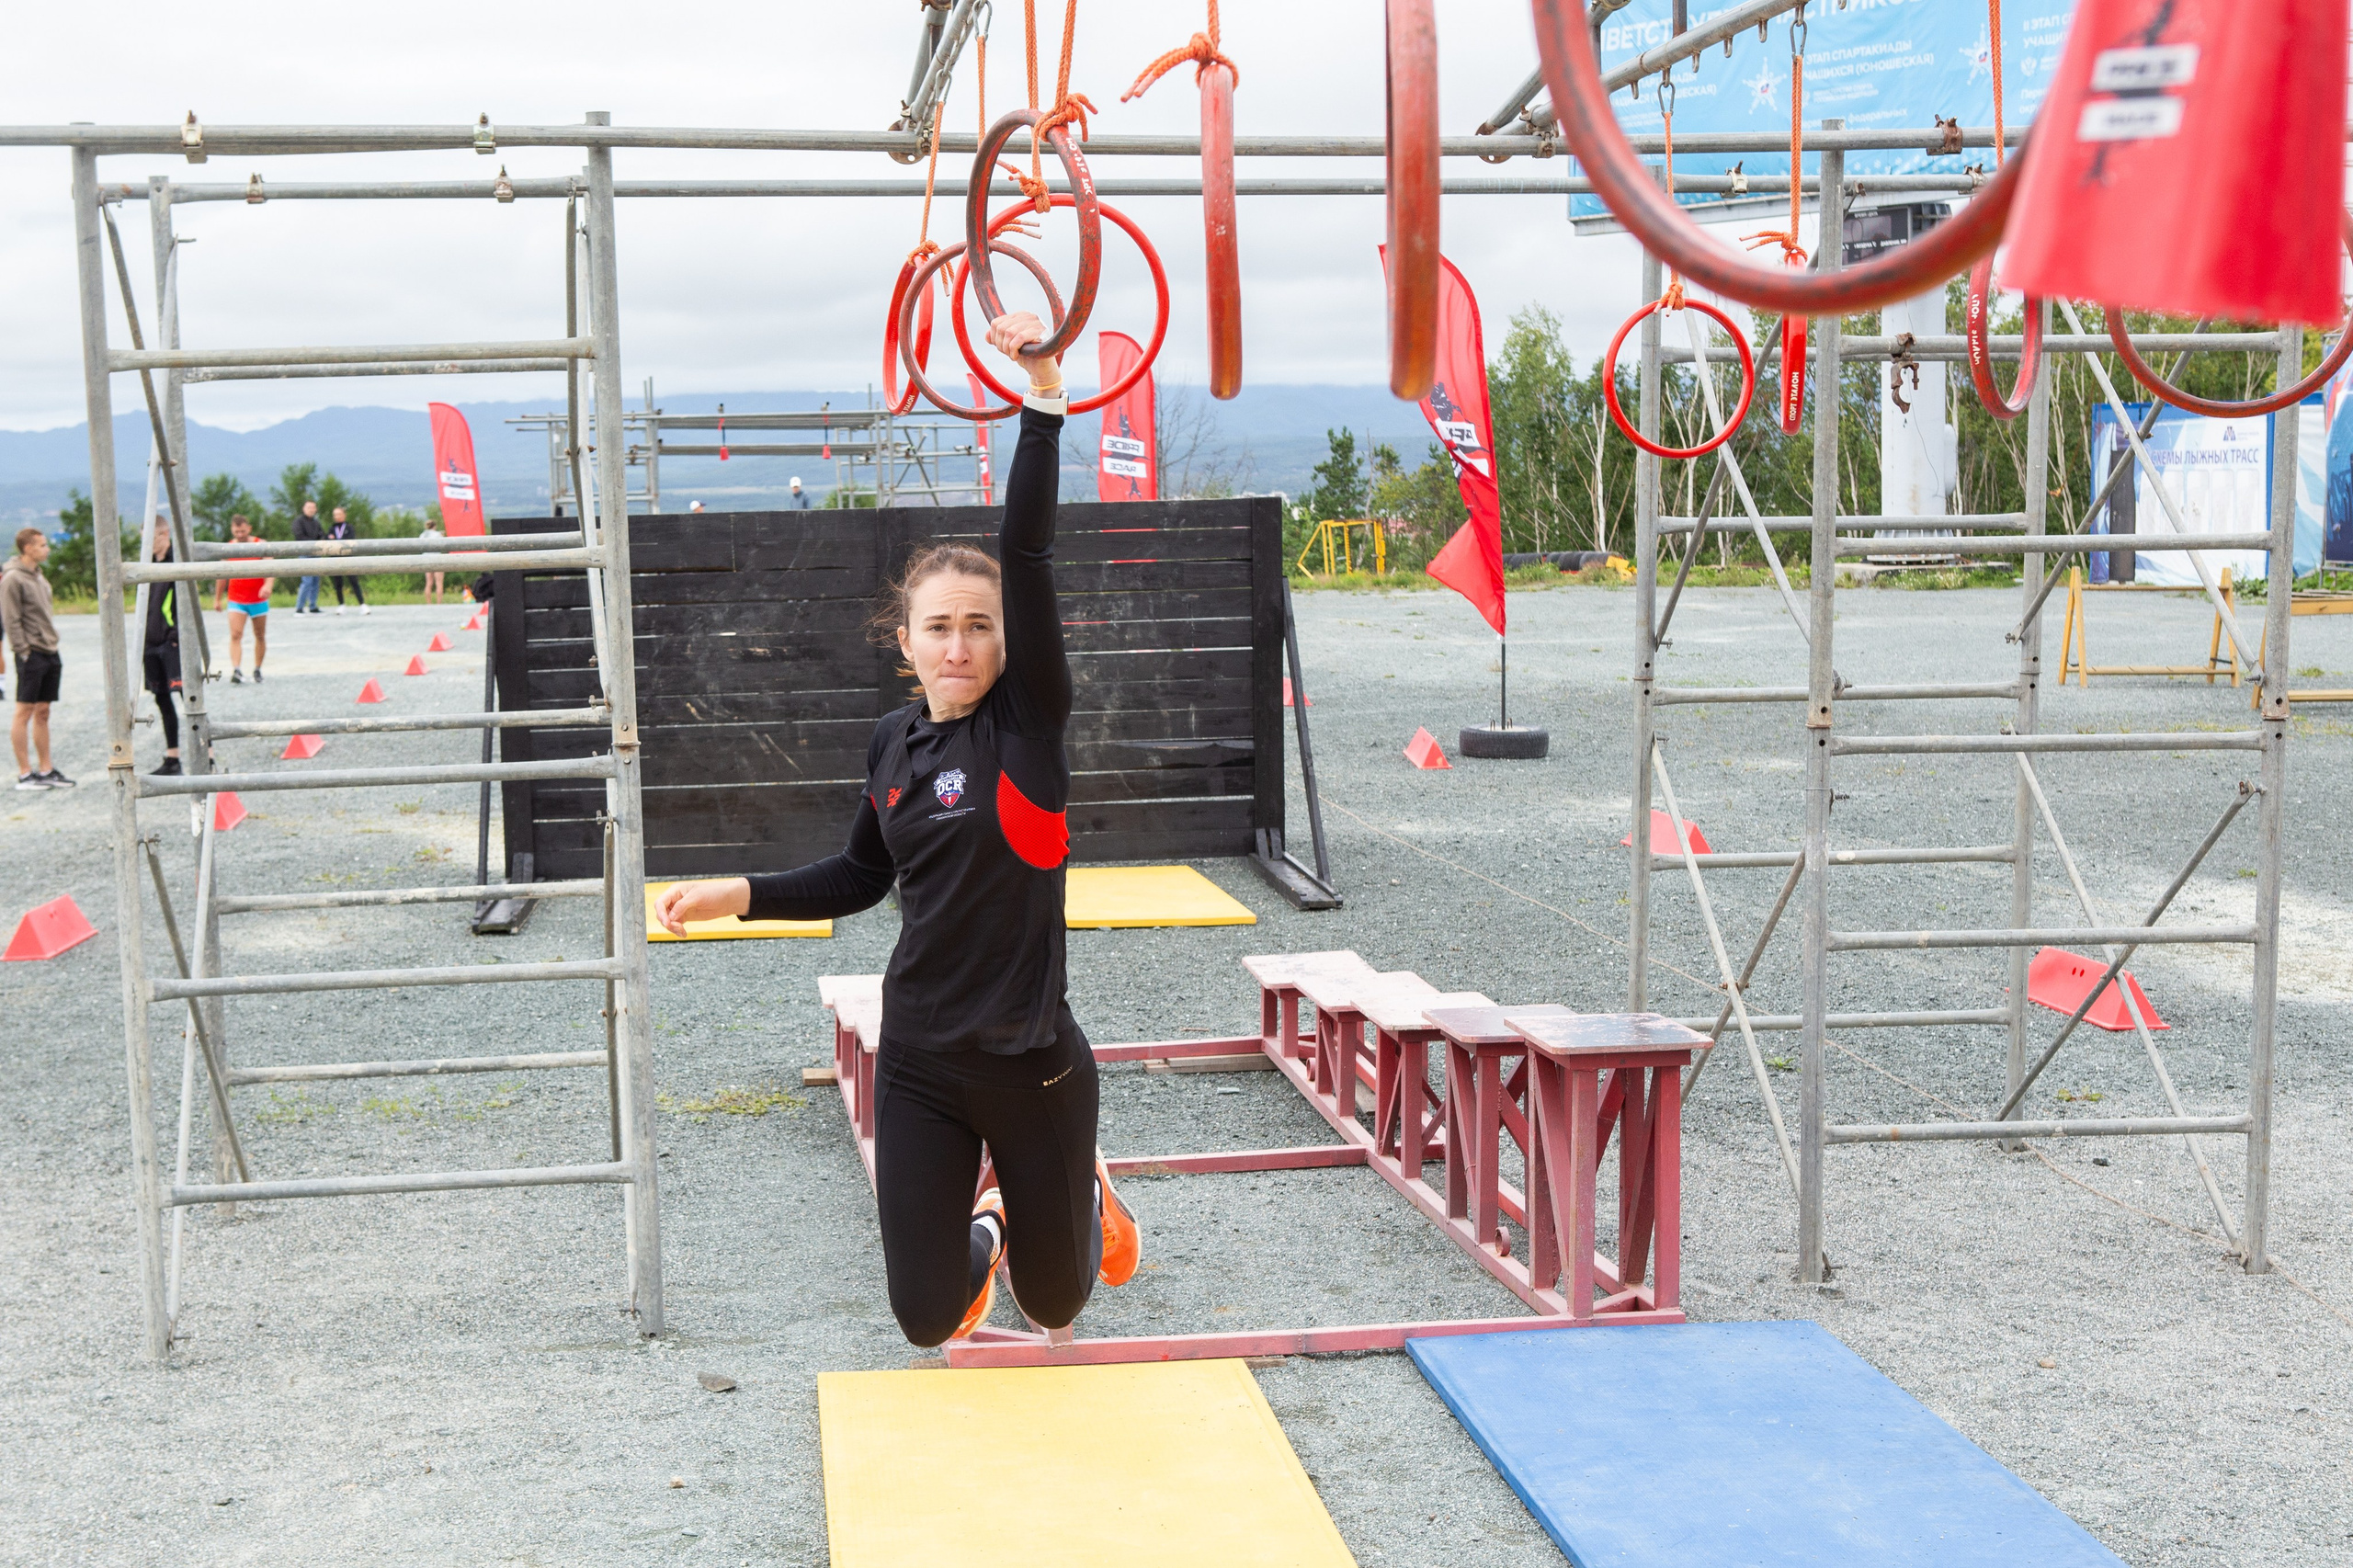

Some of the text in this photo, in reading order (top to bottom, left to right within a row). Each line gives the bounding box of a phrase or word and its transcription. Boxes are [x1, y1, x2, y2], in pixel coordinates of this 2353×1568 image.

[2031, 15, 2060, 30] ЭТАП
[1806, 40, 1913, 65] ЭТАП СПАРТАКИАДЫ
[1803, 52, 1935, 81] ЧАЩИХСЯ (ЮНОШЕСКАЯ)
[1790, 371, 1799, 401] ЭТАЛОН
[2151, 448, 2259, 465] СХЕМЫ ЛЫЖНЫХ ТРАСС
[938, 778, 962, 797] OCR
